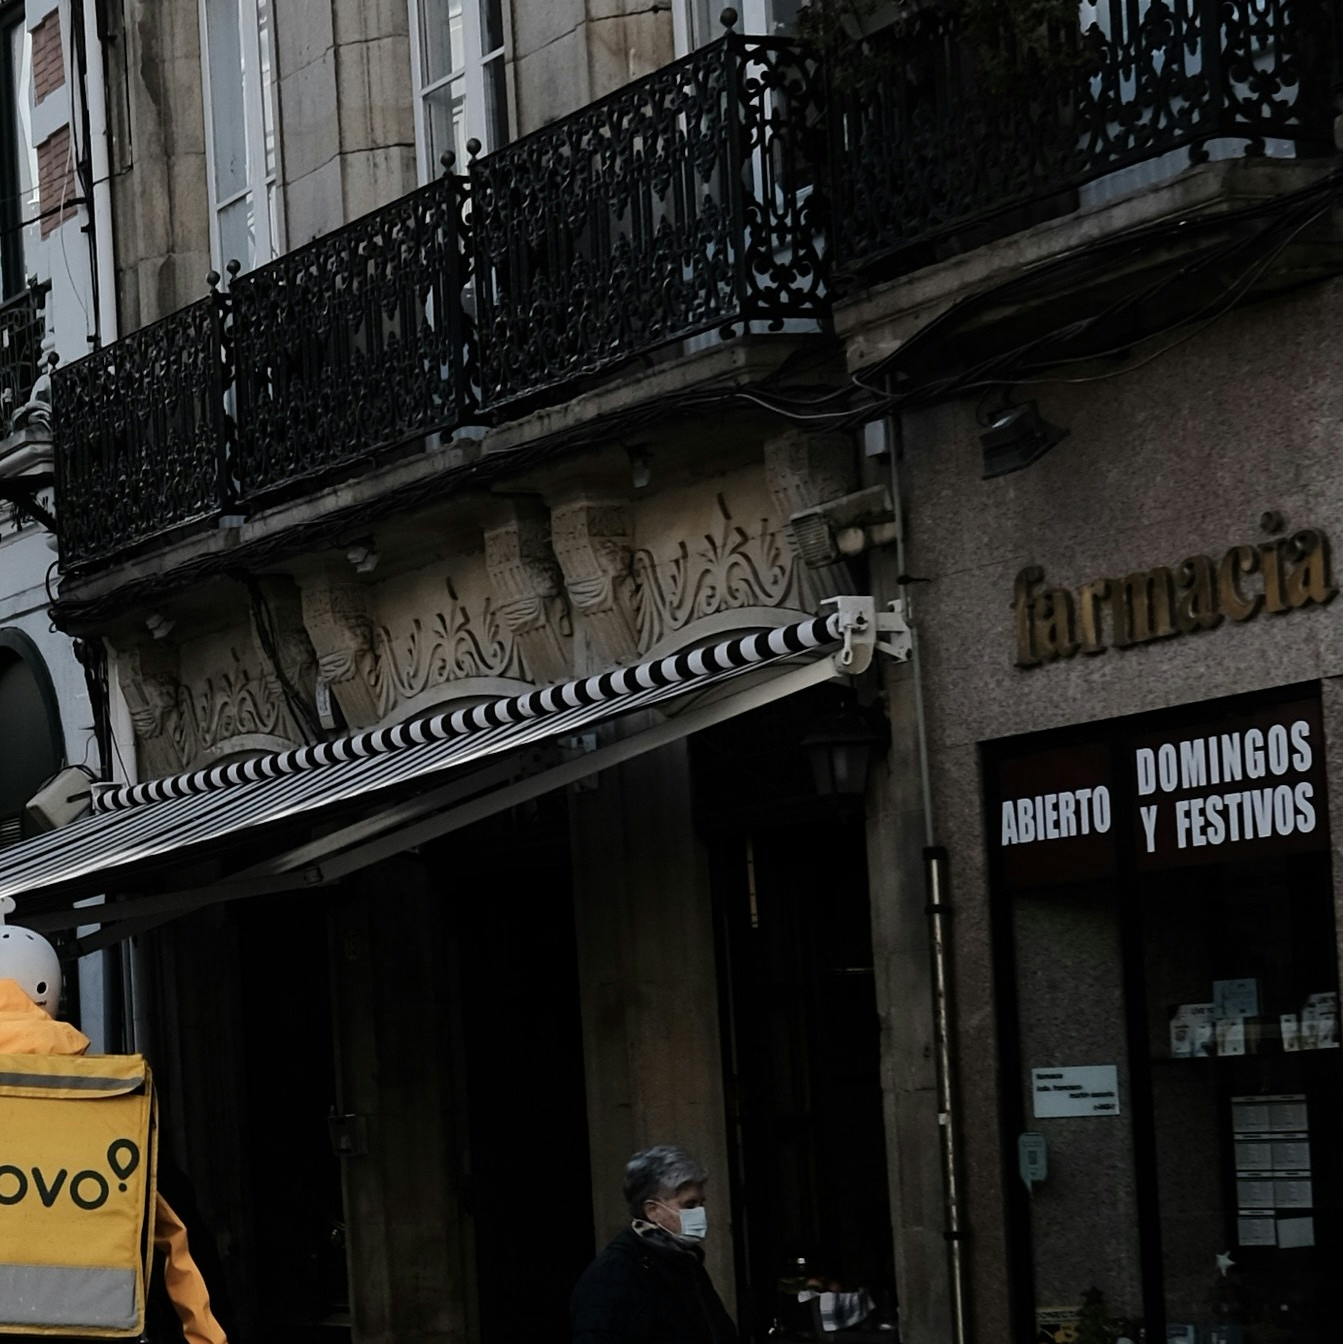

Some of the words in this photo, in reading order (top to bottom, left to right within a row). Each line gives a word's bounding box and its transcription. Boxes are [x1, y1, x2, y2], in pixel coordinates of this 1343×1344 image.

[1013, 510, 1336, 669] farmacia
[1135, 720, 1313, 796] DOMINGOS
[1001, 785, 1111, 846] ABIERTO
[1140, 805, 1158, 853] Y
[1175, 782, 1316, 848] FESTIVOS
